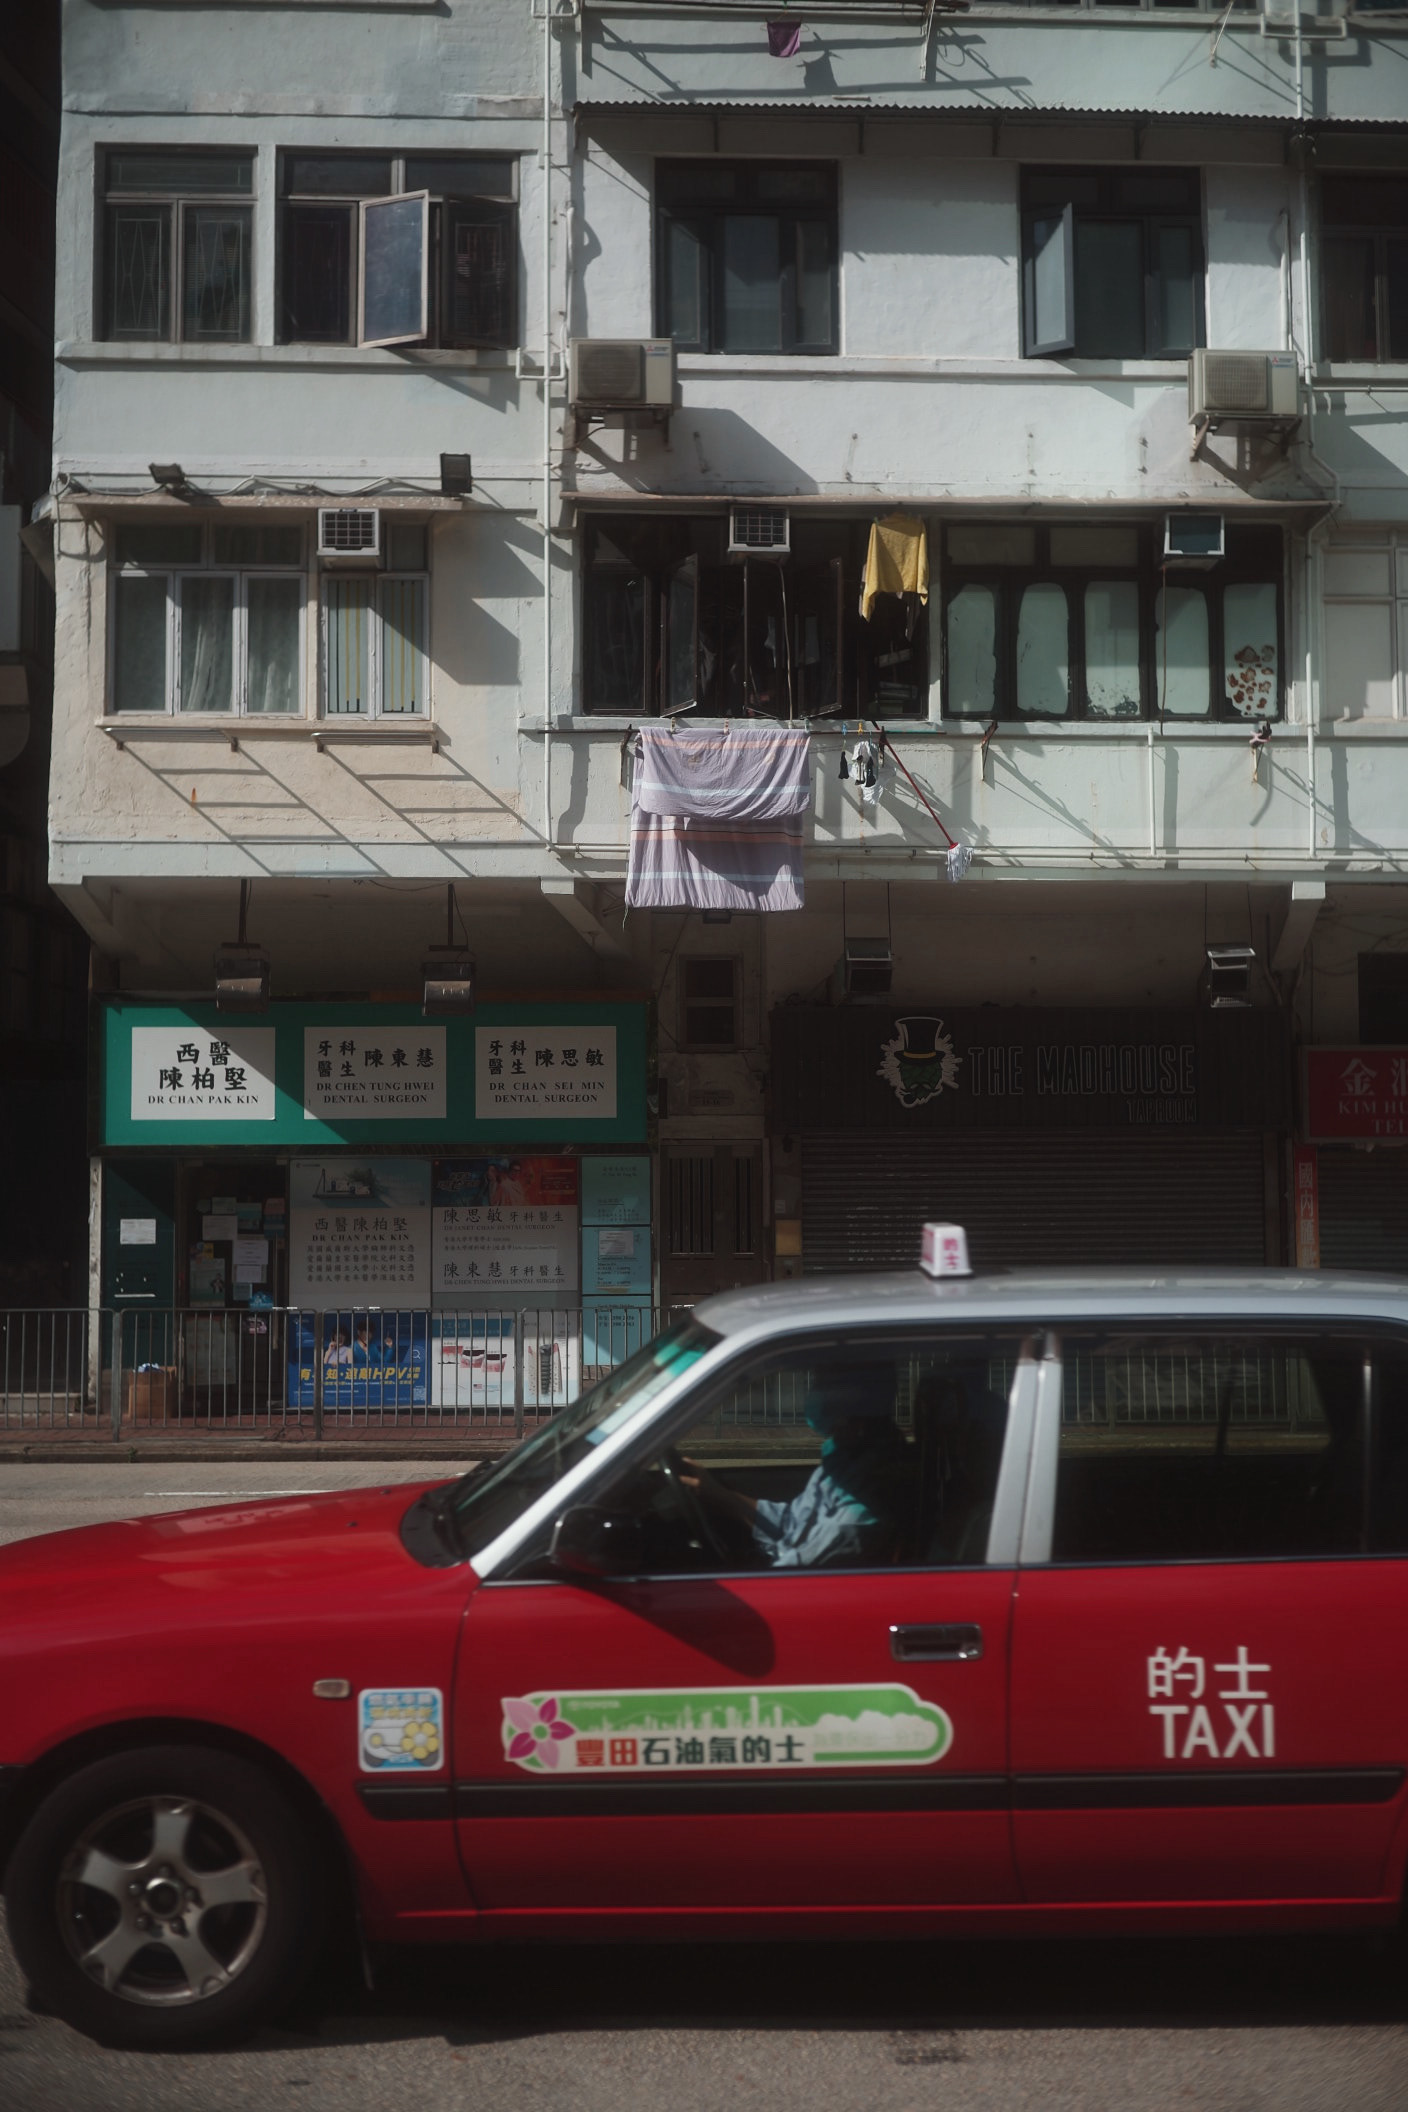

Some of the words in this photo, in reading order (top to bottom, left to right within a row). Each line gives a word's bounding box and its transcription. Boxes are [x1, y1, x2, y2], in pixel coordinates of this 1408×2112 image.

[176, 1041, 231, 1066] 西醫
[317, 1040, 356, 1057] 牙科
[488, 1040, 527, 1056] 牙科
[364, 1048, 434, 1068] 陳東慧
[535, 1048, 605, 1067] 陳思敏
[317, 1060, 356, 1077] 醫生
[488, 1058, 527, 1075] 醫生
[967, 1047, 1024, 1096] THE
[1036, 1046, 1198, 1095] MADHOUSE
[159, 1066, 248, 1091] 陳柏堅
[316, 1082, 332, 1091] DR
[335, 1082, 366, 1091] CHEN
[369, 1082, 401, 1091] TUNG
[404, 1082, 435, 1091] HWEI
[489, 1082, 505, 1091] DR
[513, 1082, 547, 1091] CHAN
[554, 1082, 573, 1091] SEI
[581, 1082, 605, 1091] MIN
[148, 1095, 164, 1104] DR
[168, 1095, 203, 1104] CHAN
[208, 1095, 232, 1104] PAK
[236, 1095, 259, 1104] KIN
[323, 1094, 368, 1104] DENTAL
[373, 1094, 428, 1104] SURGEON
[495, 1094, 539, 1103] DENTAL
[544, 1094, 598, 1103] SURGEON
[1338, 1100, 1376, 1114] KIM
[1126, 1097, 1197, 1123] TAPROOM
[443, 1207, 503, 1223] 陳思敏
[509, 1211, 564, 1223] 牙科醫生
[315, 1216, 408, 1232] 西醫陳柏堅
[312, 1234, 326, 1242] DR
[330, 1234, 361, 1242] CHAN
[365, 1234, 385, 1242] PAK
[443, 1261, 503, 1278] 陳東慧
[509, 1265, 565, 1277] 牙科醫生
[1147, 1645, 1272, 1699] 的士
[1148, 1704, 1276, 1759] TAXI
[575, 1734, 805, 1768] 豐田石油氣的士
